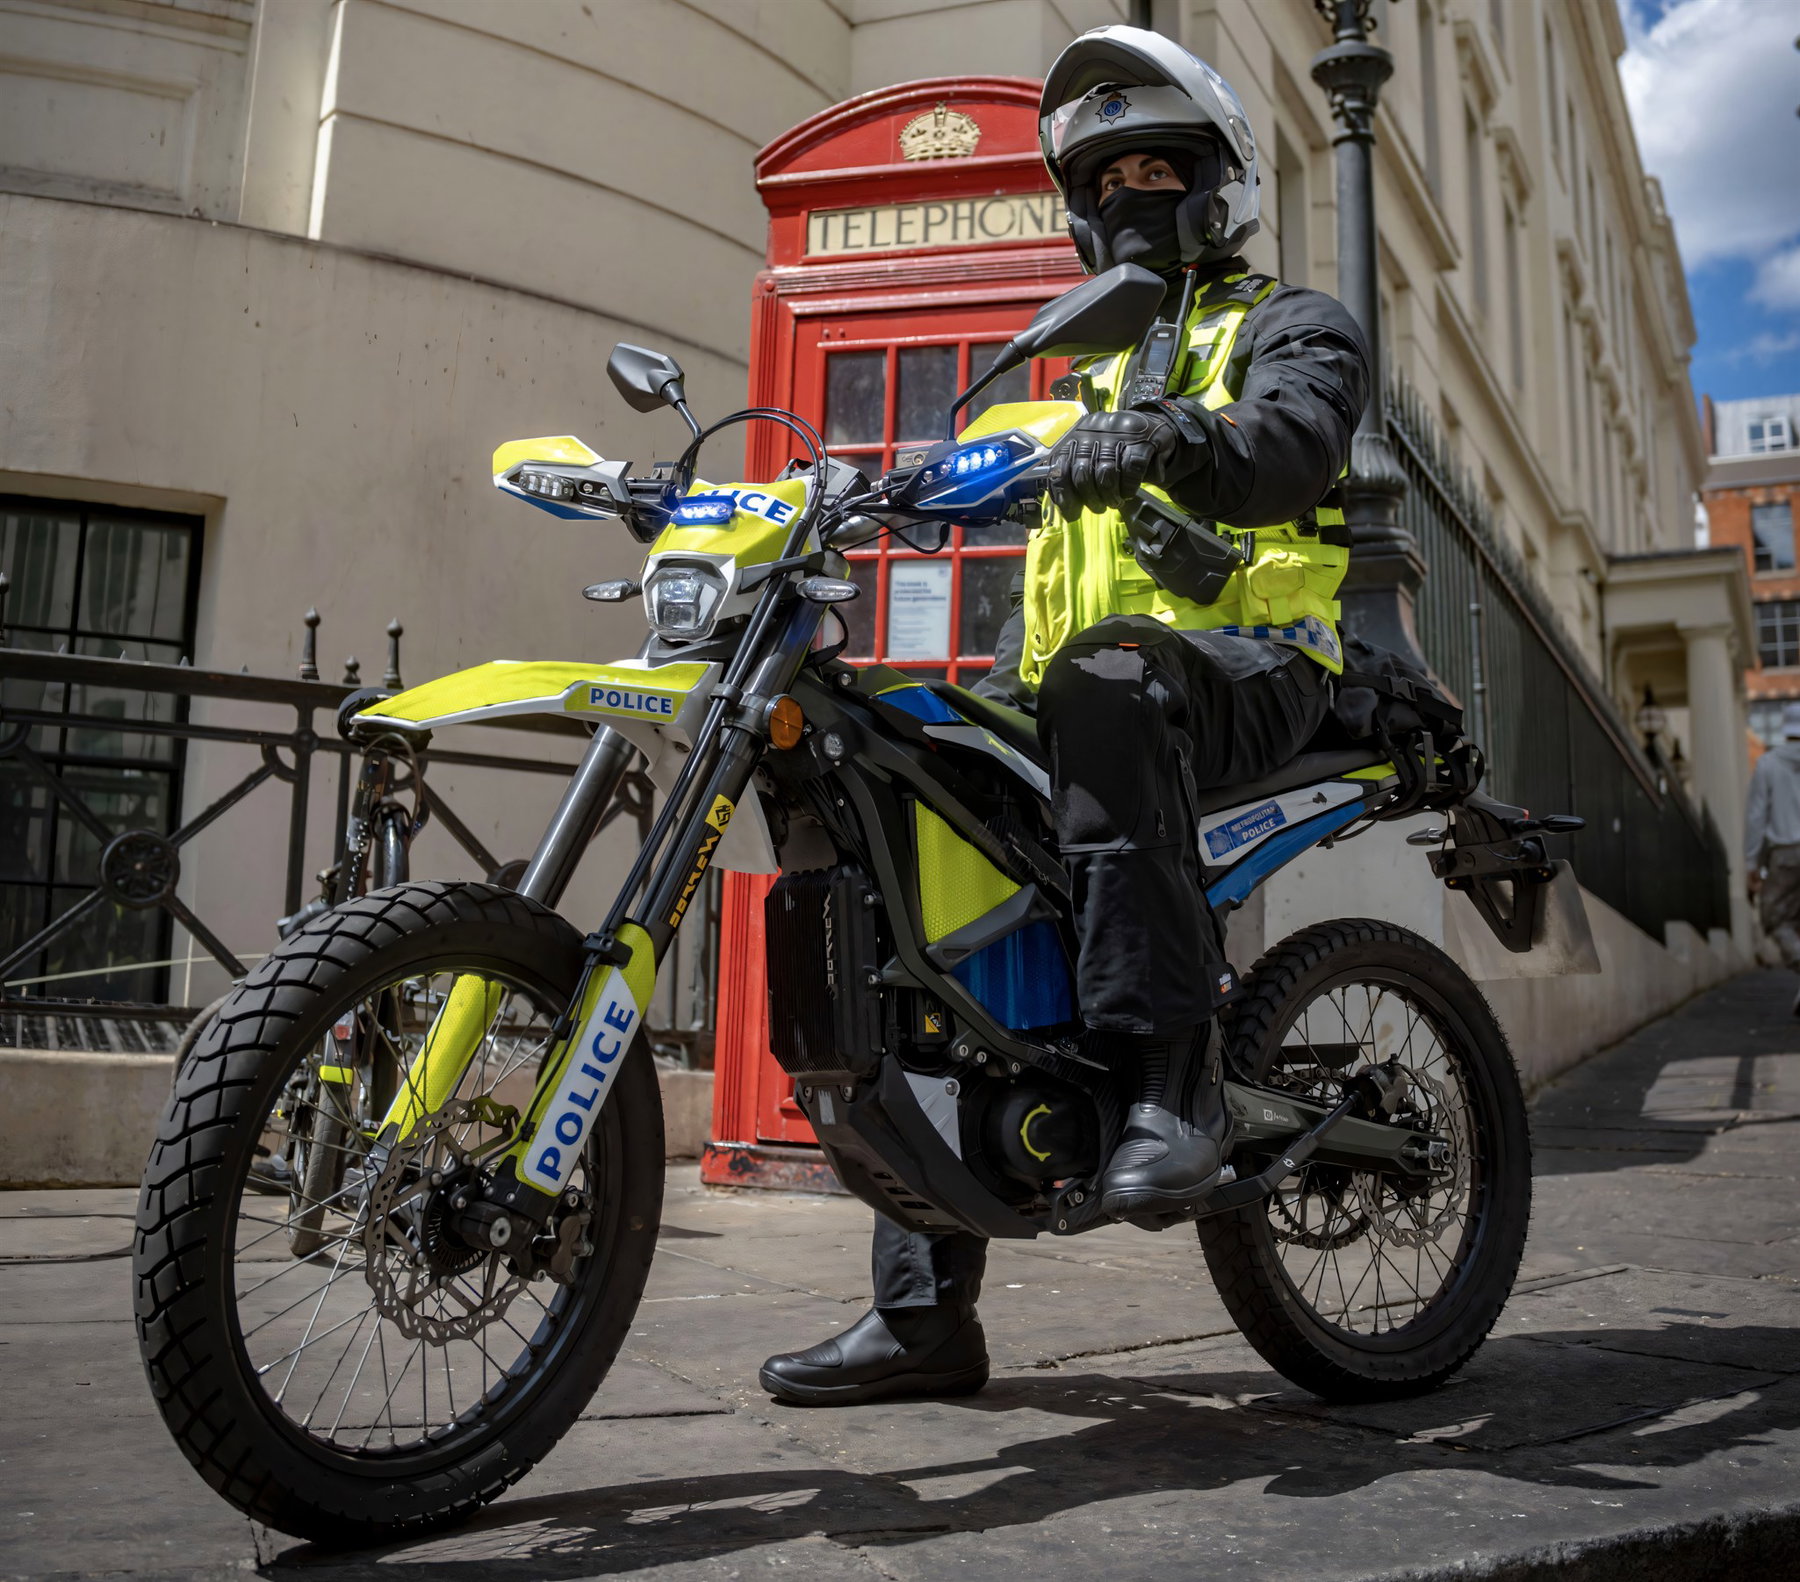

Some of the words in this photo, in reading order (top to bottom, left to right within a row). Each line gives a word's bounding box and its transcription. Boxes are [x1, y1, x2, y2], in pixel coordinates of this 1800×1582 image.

[812, 196, 1069, 250] TELEPHONE
[590, 688, 672, 714] POLICE
[1231, 806, 1276, 832] METROPOLITAN
[1242, 818, 1276, 842] POLICE
[536, 1001, 635, 1181] POLICE
